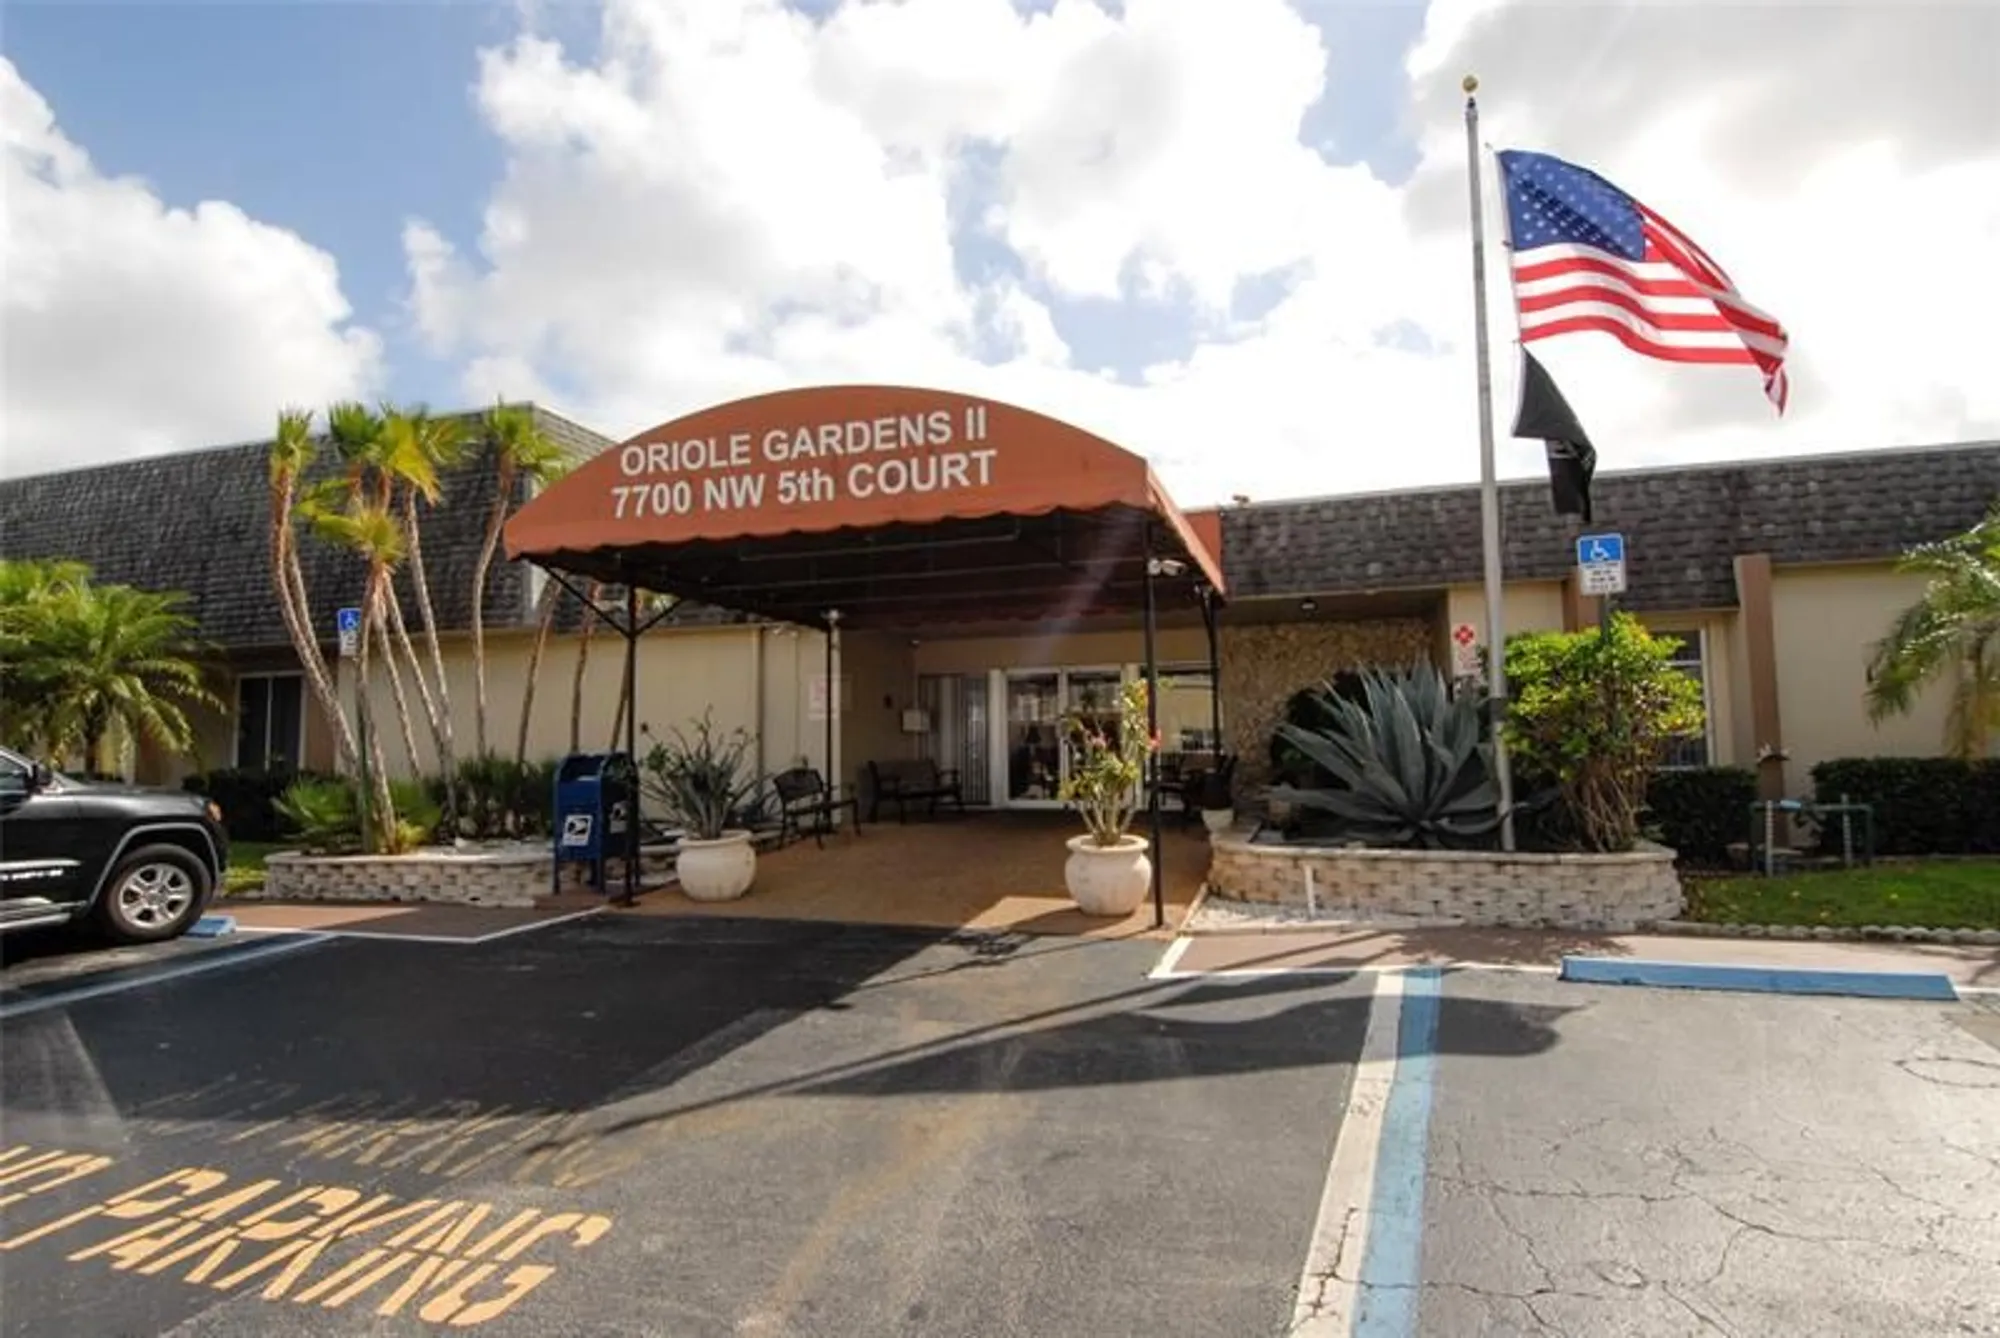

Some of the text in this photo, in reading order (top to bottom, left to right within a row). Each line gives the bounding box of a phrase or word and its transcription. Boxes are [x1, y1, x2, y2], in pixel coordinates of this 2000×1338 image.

[620, 434, 752, 476] ORIOLE
[762, 411, 952, 462] GARDENS
[611, 448, 998, 519] 7700 NW 5th COURT
[0, 1166, 611, 1326] PARKING
